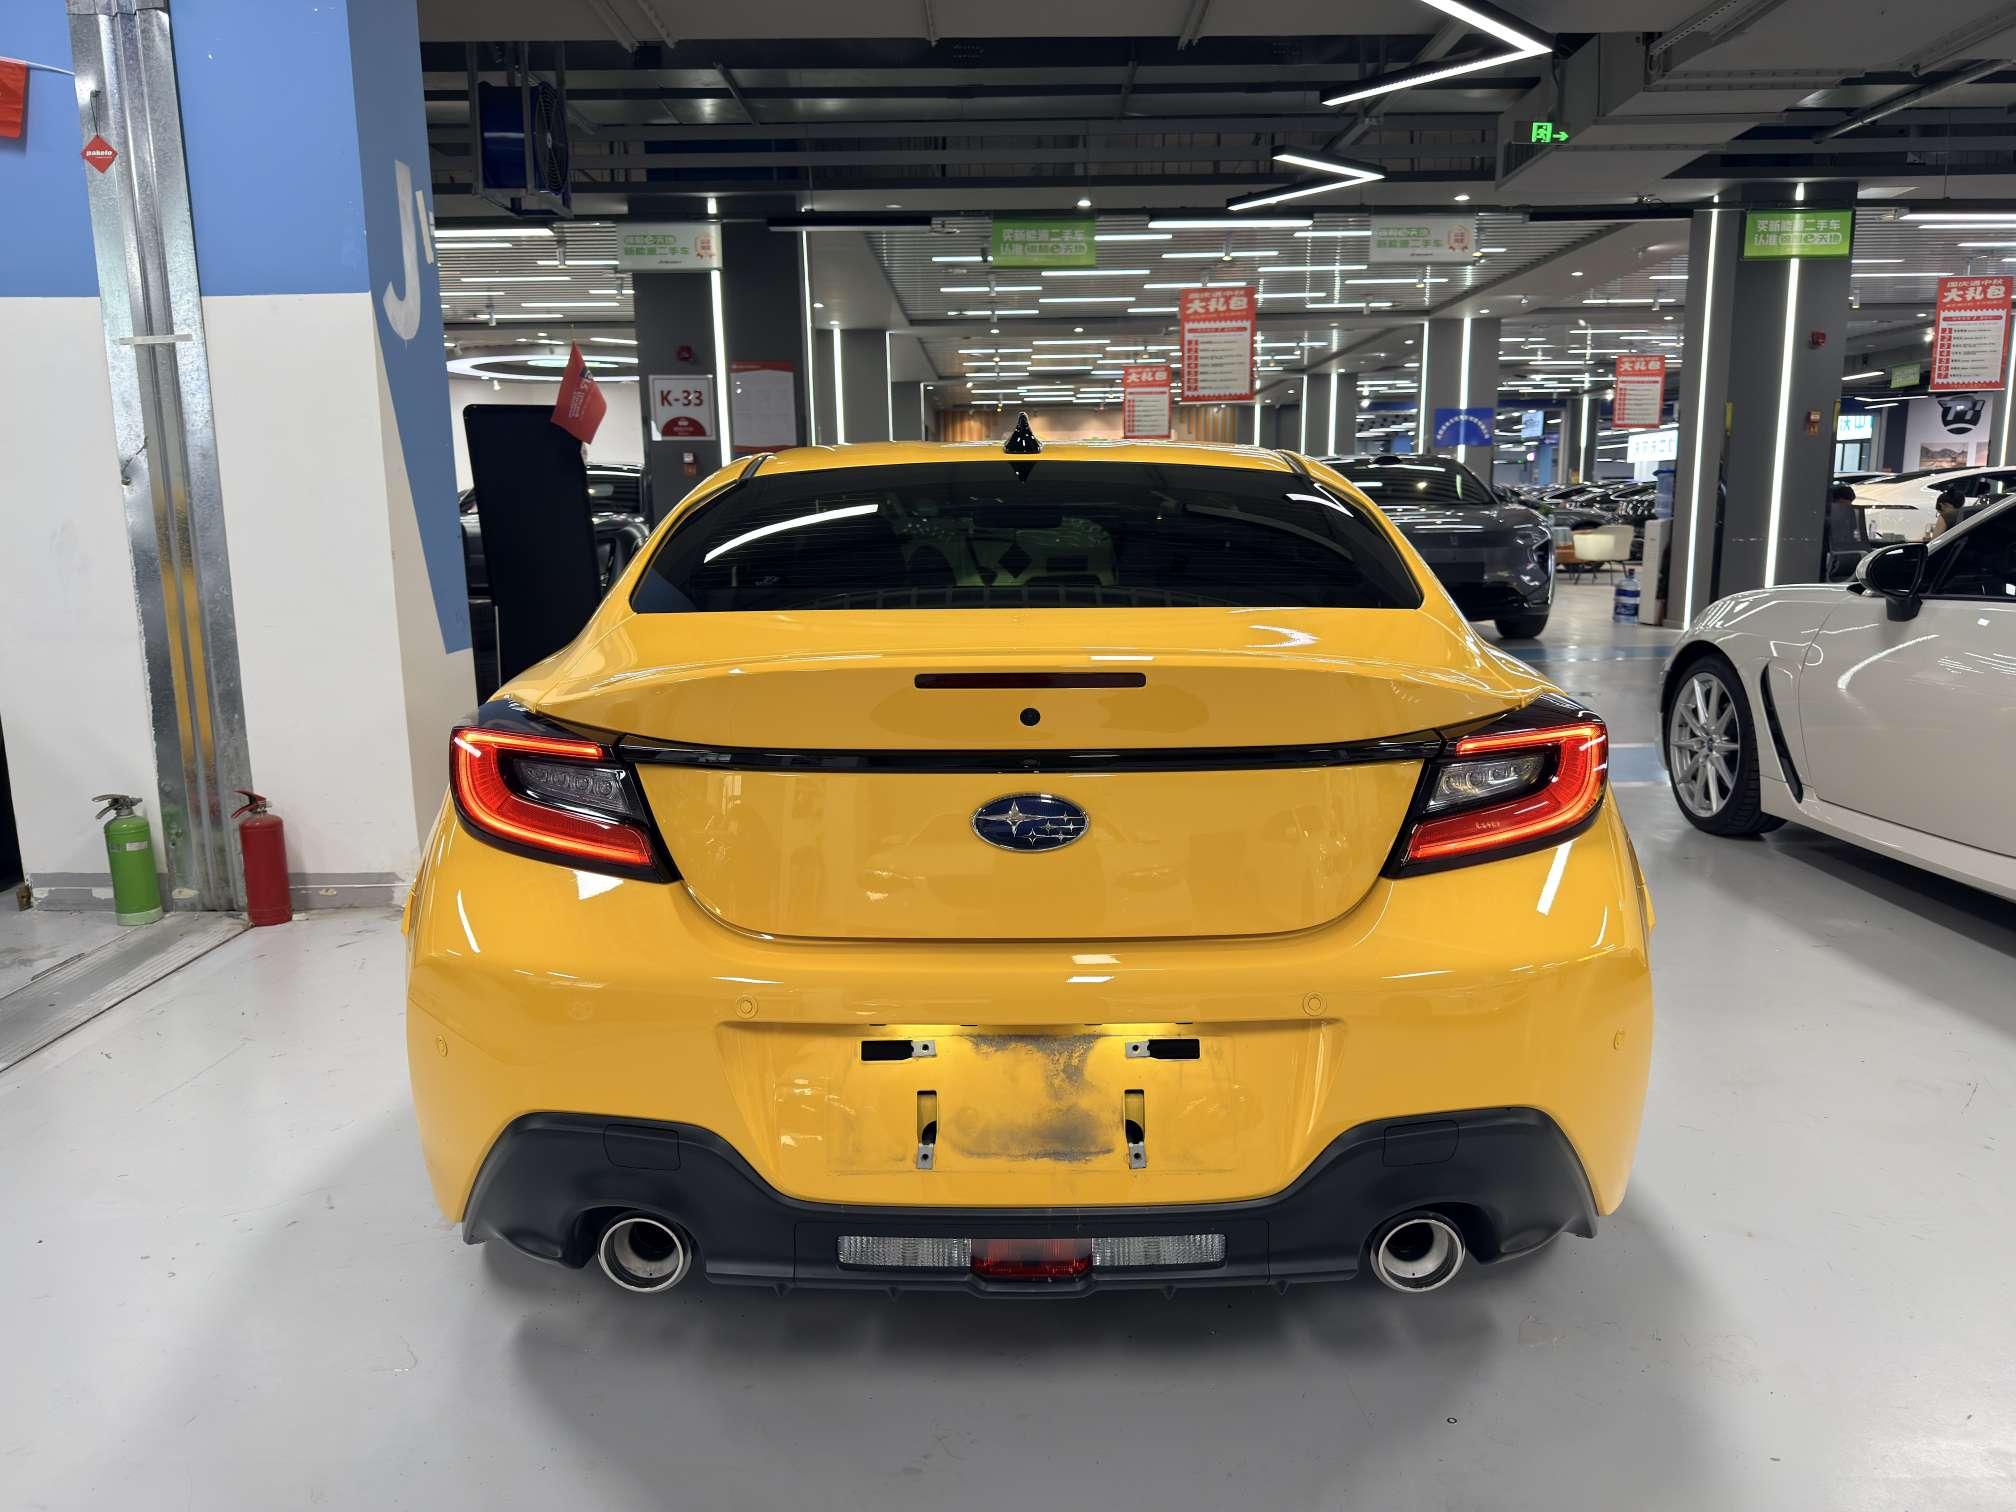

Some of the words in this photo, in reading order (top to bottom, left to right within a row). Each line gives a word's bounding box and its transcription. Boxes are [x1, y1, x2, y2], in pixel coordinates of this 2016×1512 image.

[1941, 286, 2005, 303] 大礼包
[1185, 297, 1248, 314] 大礼包
[1620, 360, 1661, 371] 大礼包
[1127, 371, 1167, 382] 大礼包
[660, 389, 704, 407] K-33
